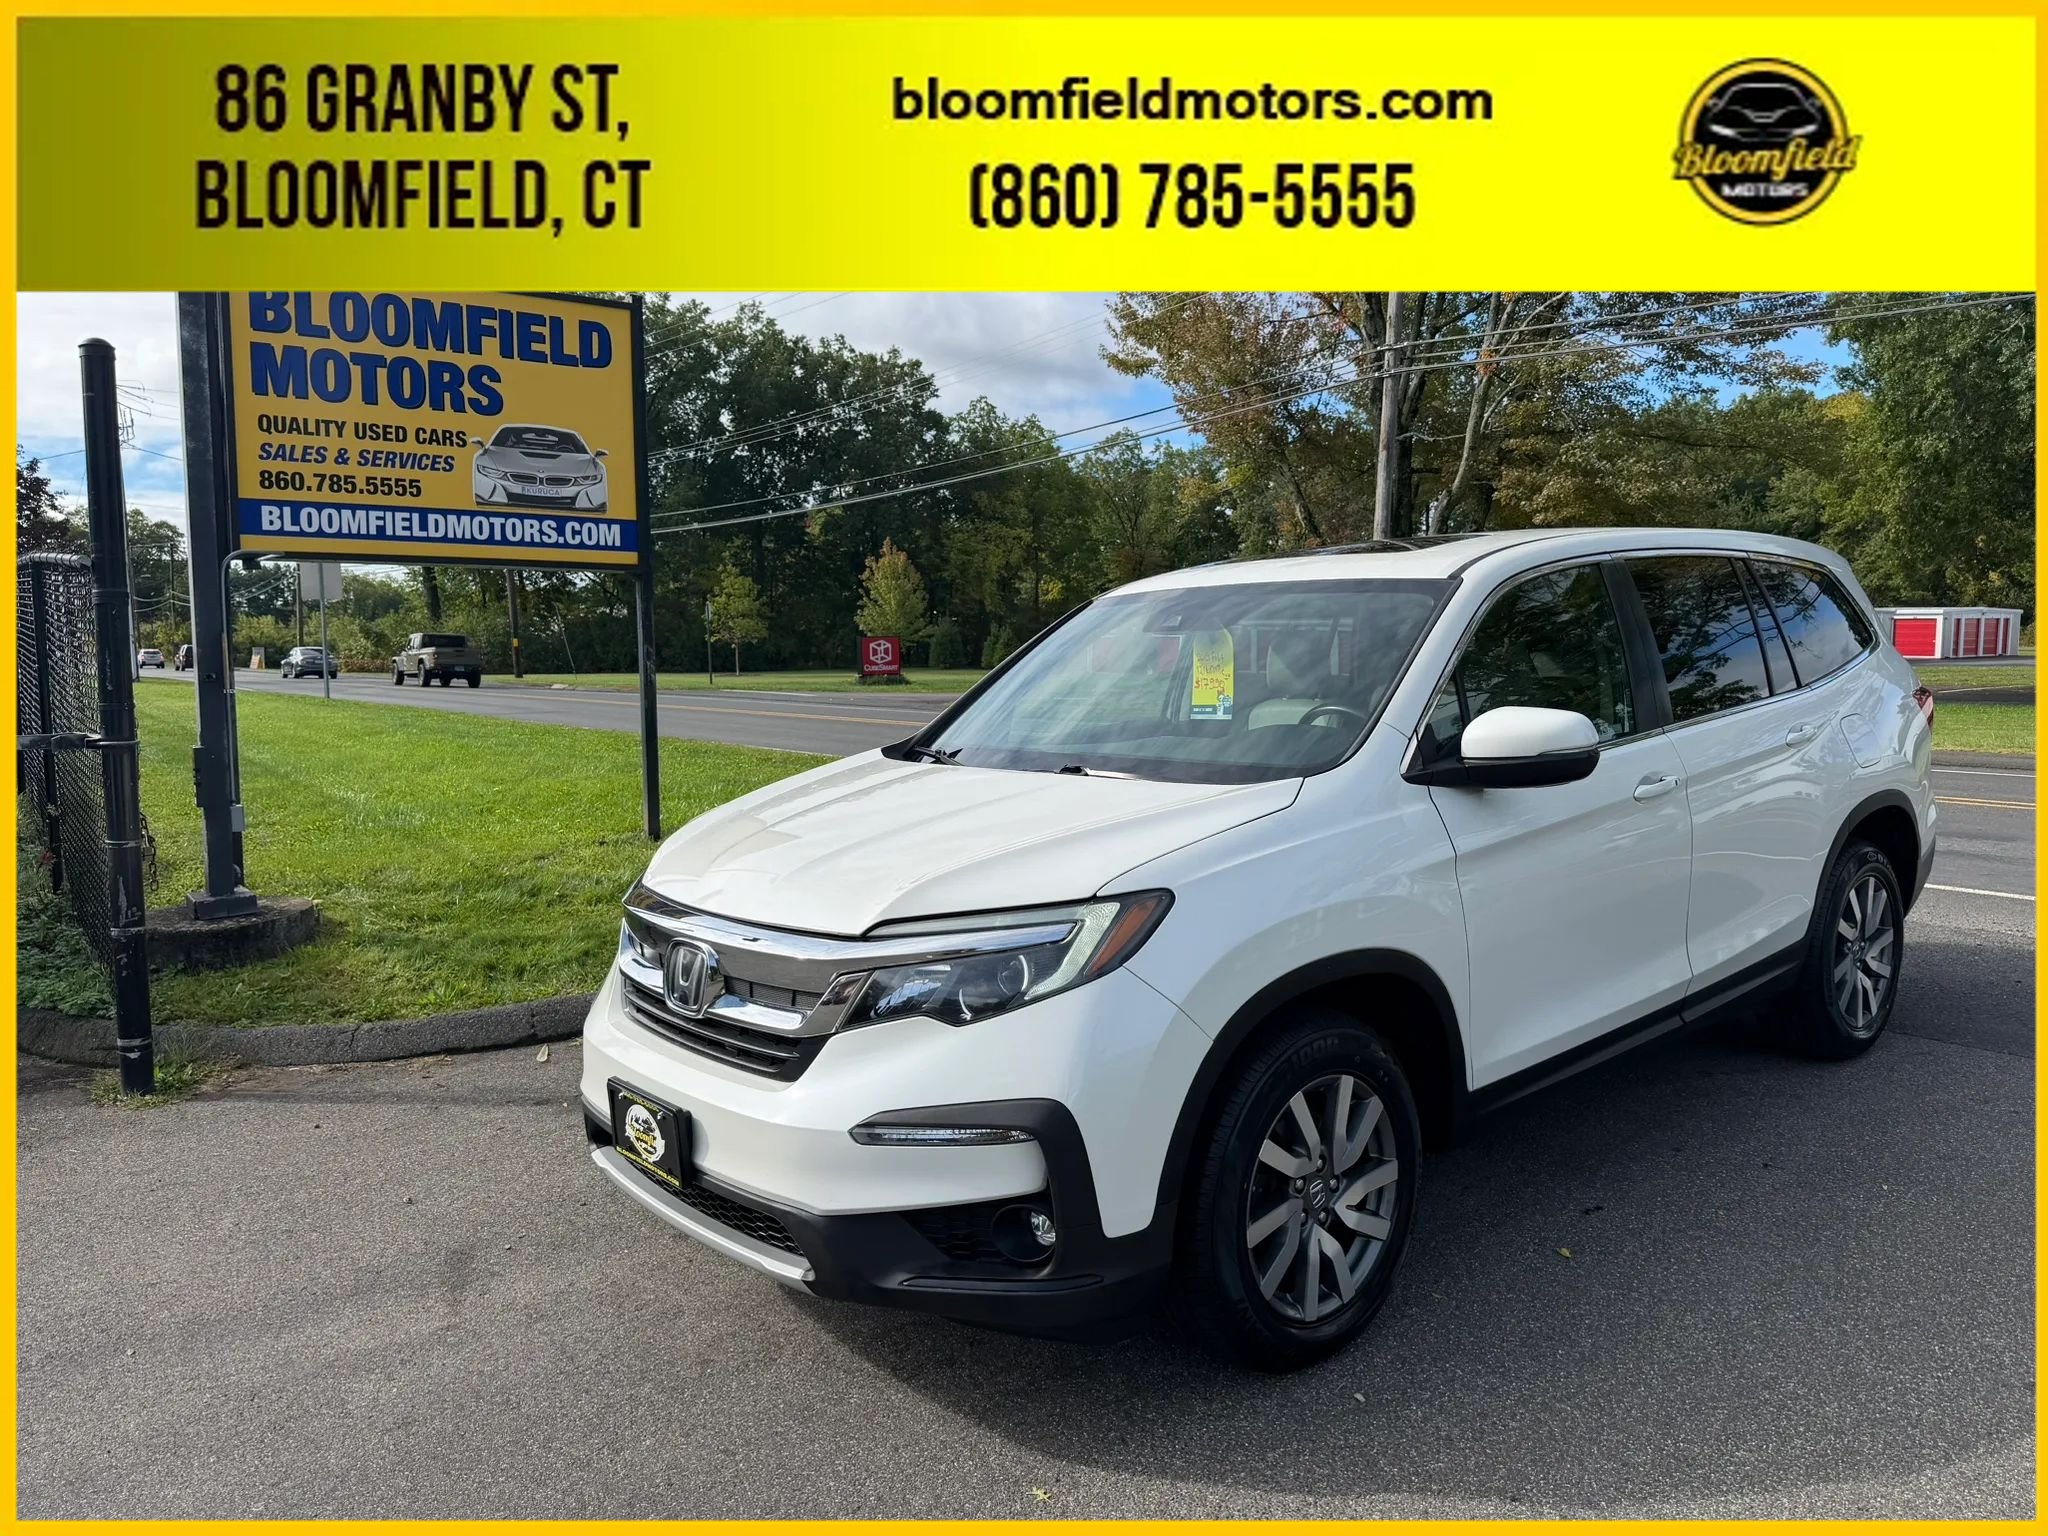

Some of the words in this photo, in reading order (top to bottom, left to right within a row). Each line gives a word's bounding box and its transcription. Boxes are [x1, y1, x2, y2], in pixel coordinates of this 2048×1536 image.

[248, 291, 613, 370] BLOOMFIELD
[249, 341, 505, 417] MOTORS
[257, 413, 347, 440] QUALITY
[353, 422, 408, 444] USED
[414, 427, 468, 449] CARS
[258, 442, 328, 465] SALES
[333, 446, 351, 466] &
[357, 448, 456, 473] SERVICES
[258, 470, 422, 498] 860.785.5555
[260, 504, 622, 547] BLOOMFIELDMOTORS.COM
